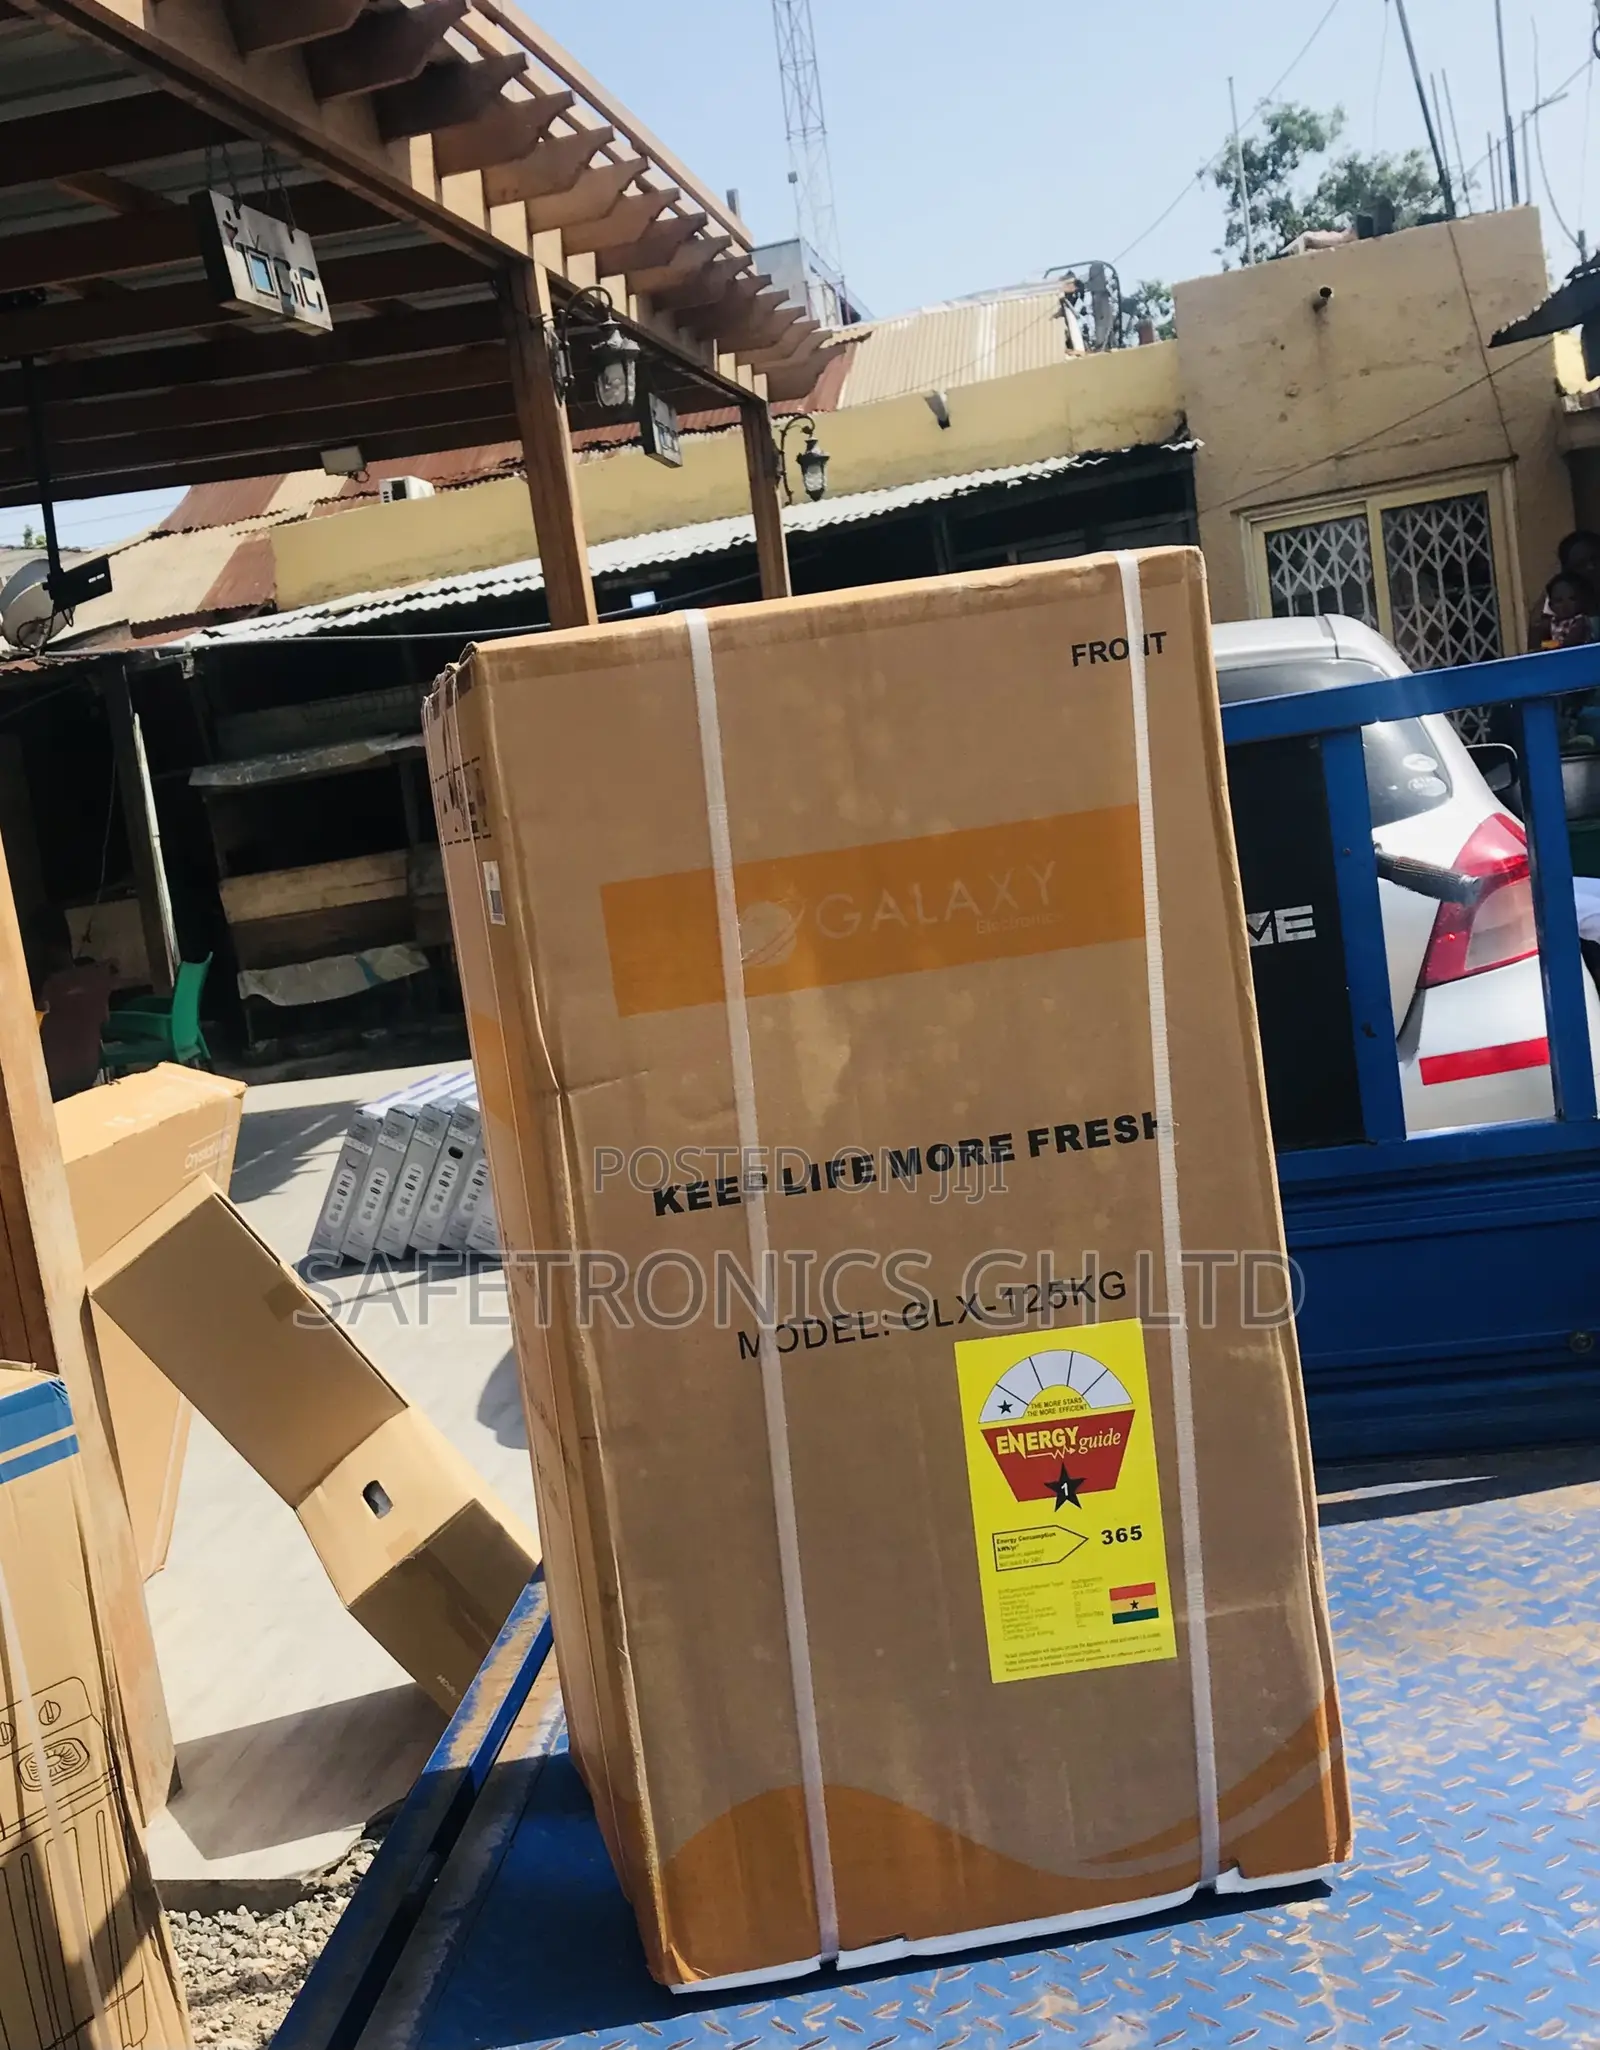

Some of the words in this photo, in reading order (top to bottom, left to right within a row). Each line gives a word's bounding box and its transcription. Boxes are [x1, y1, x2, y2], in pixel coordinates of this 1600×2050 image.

[1071, 631, 1168, 667] FROT
[815, 859, 1058, 942] GALAXY
[975, 911, 1066, 936] Electronics
[652, 1171, 768, 1217] KEE
[782, 1153, 876, 1197] LIFE
[888, 1131, 1017, 1180] MORE
[737, 1310, 891, 1360] MODEL:
[901, 1270, 1127, 1332] GLX-125KG
[1039, 1407, 1057, 1416] MORE
[1058, 1403, 1088, 1414] EFFICIENT
[1043, 1399, 1062, 1408] MORE
[1062, 1397, 1083, 1406] STARS
[995, 1425, 1080, 1460] ENERGY
[1077, 1427, 1122, 1455] guide
[1060, 1482, 1069, 1497] 1
[996, 1537, 1018, 1546] Energy
[1018, 1531, 1057, 1543] Consumption
[1100, 1525, 1143, 1545] 365
